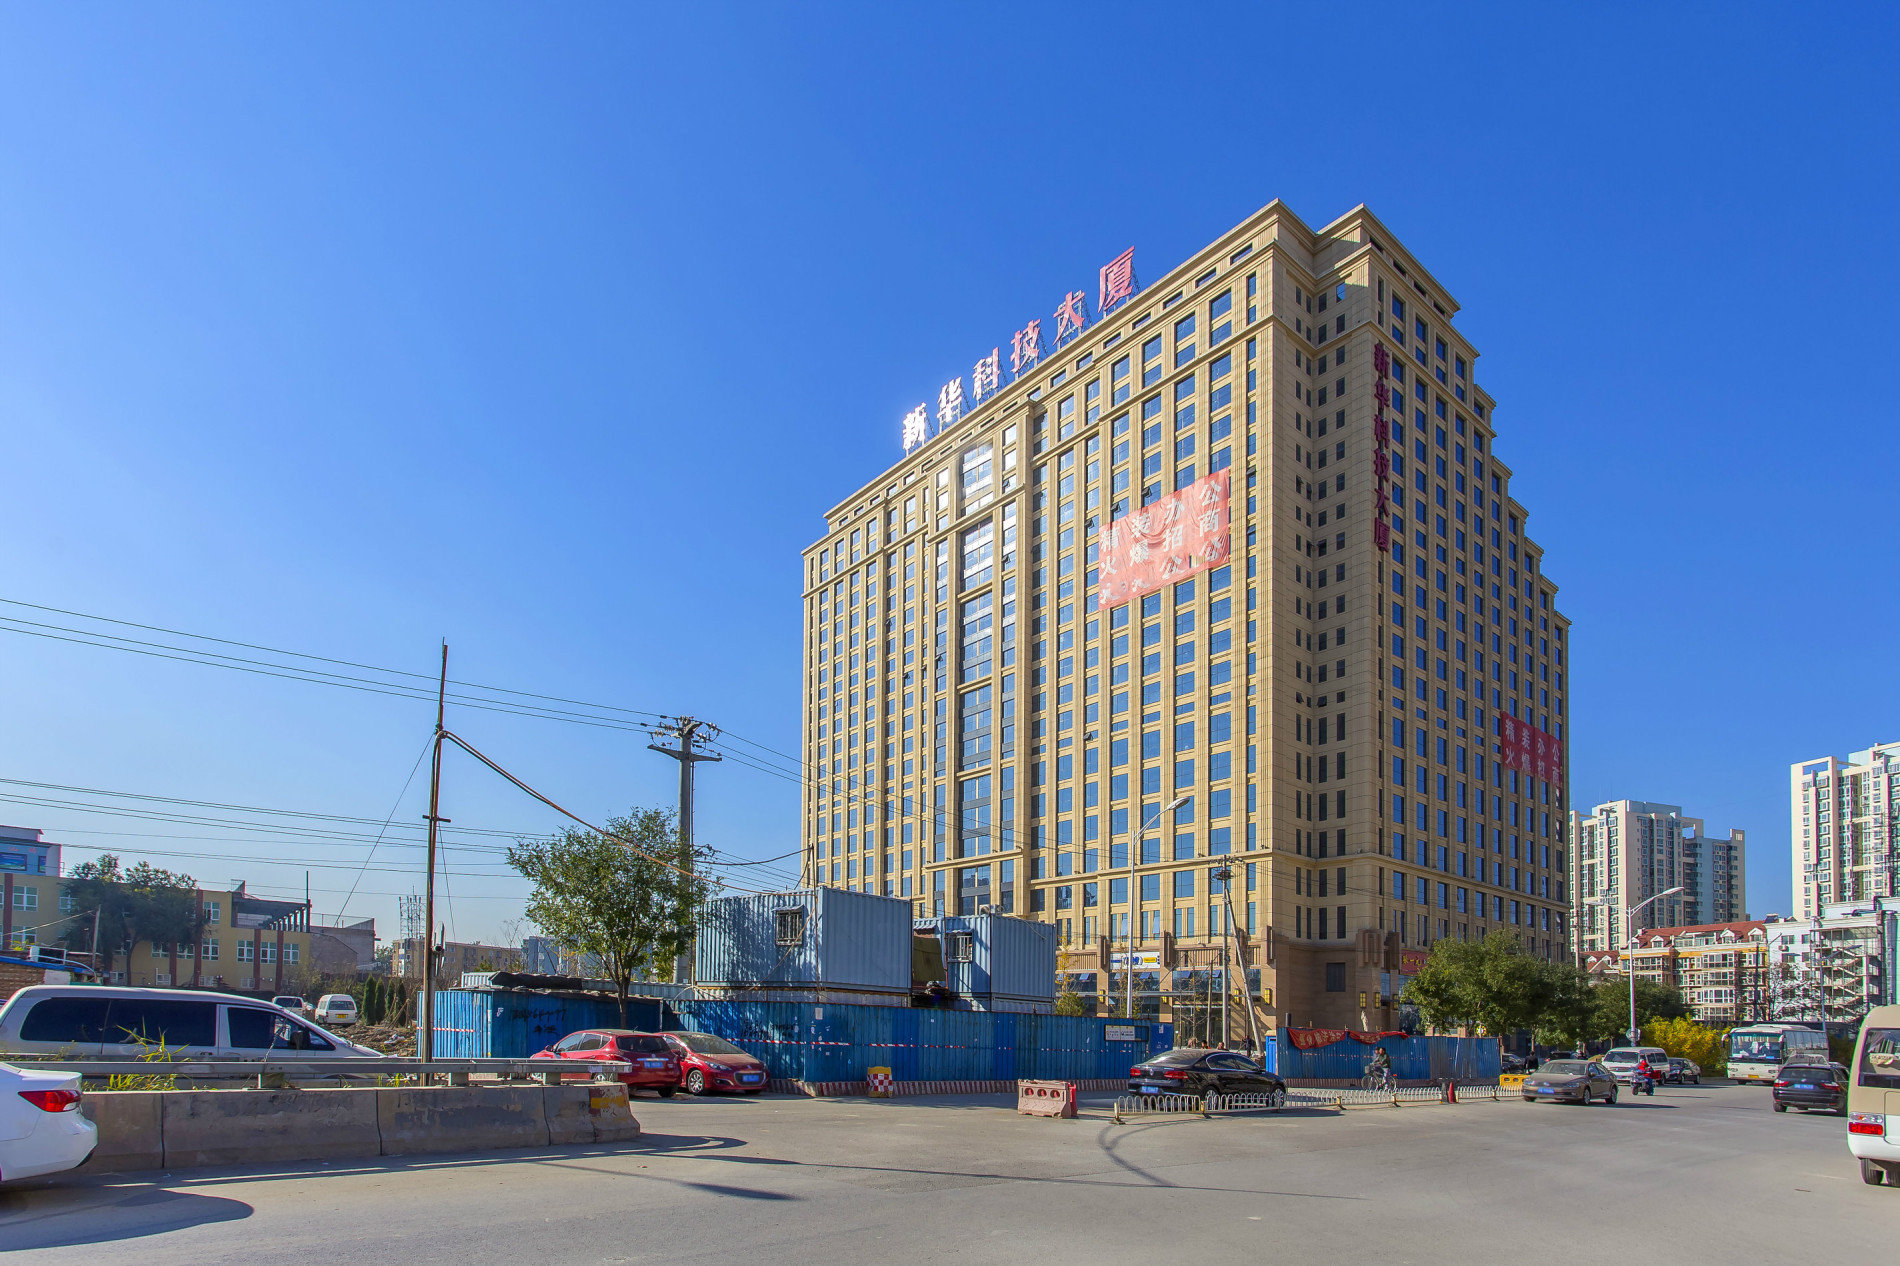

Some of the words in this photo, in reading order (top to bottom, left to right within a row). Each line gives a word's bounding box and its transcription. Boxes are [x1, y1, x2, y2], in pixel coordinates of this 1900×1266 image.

[903, 246, 1135, 450] 新华科技大厦
[1374, 342, 1390, 552] 新华科技大厦
